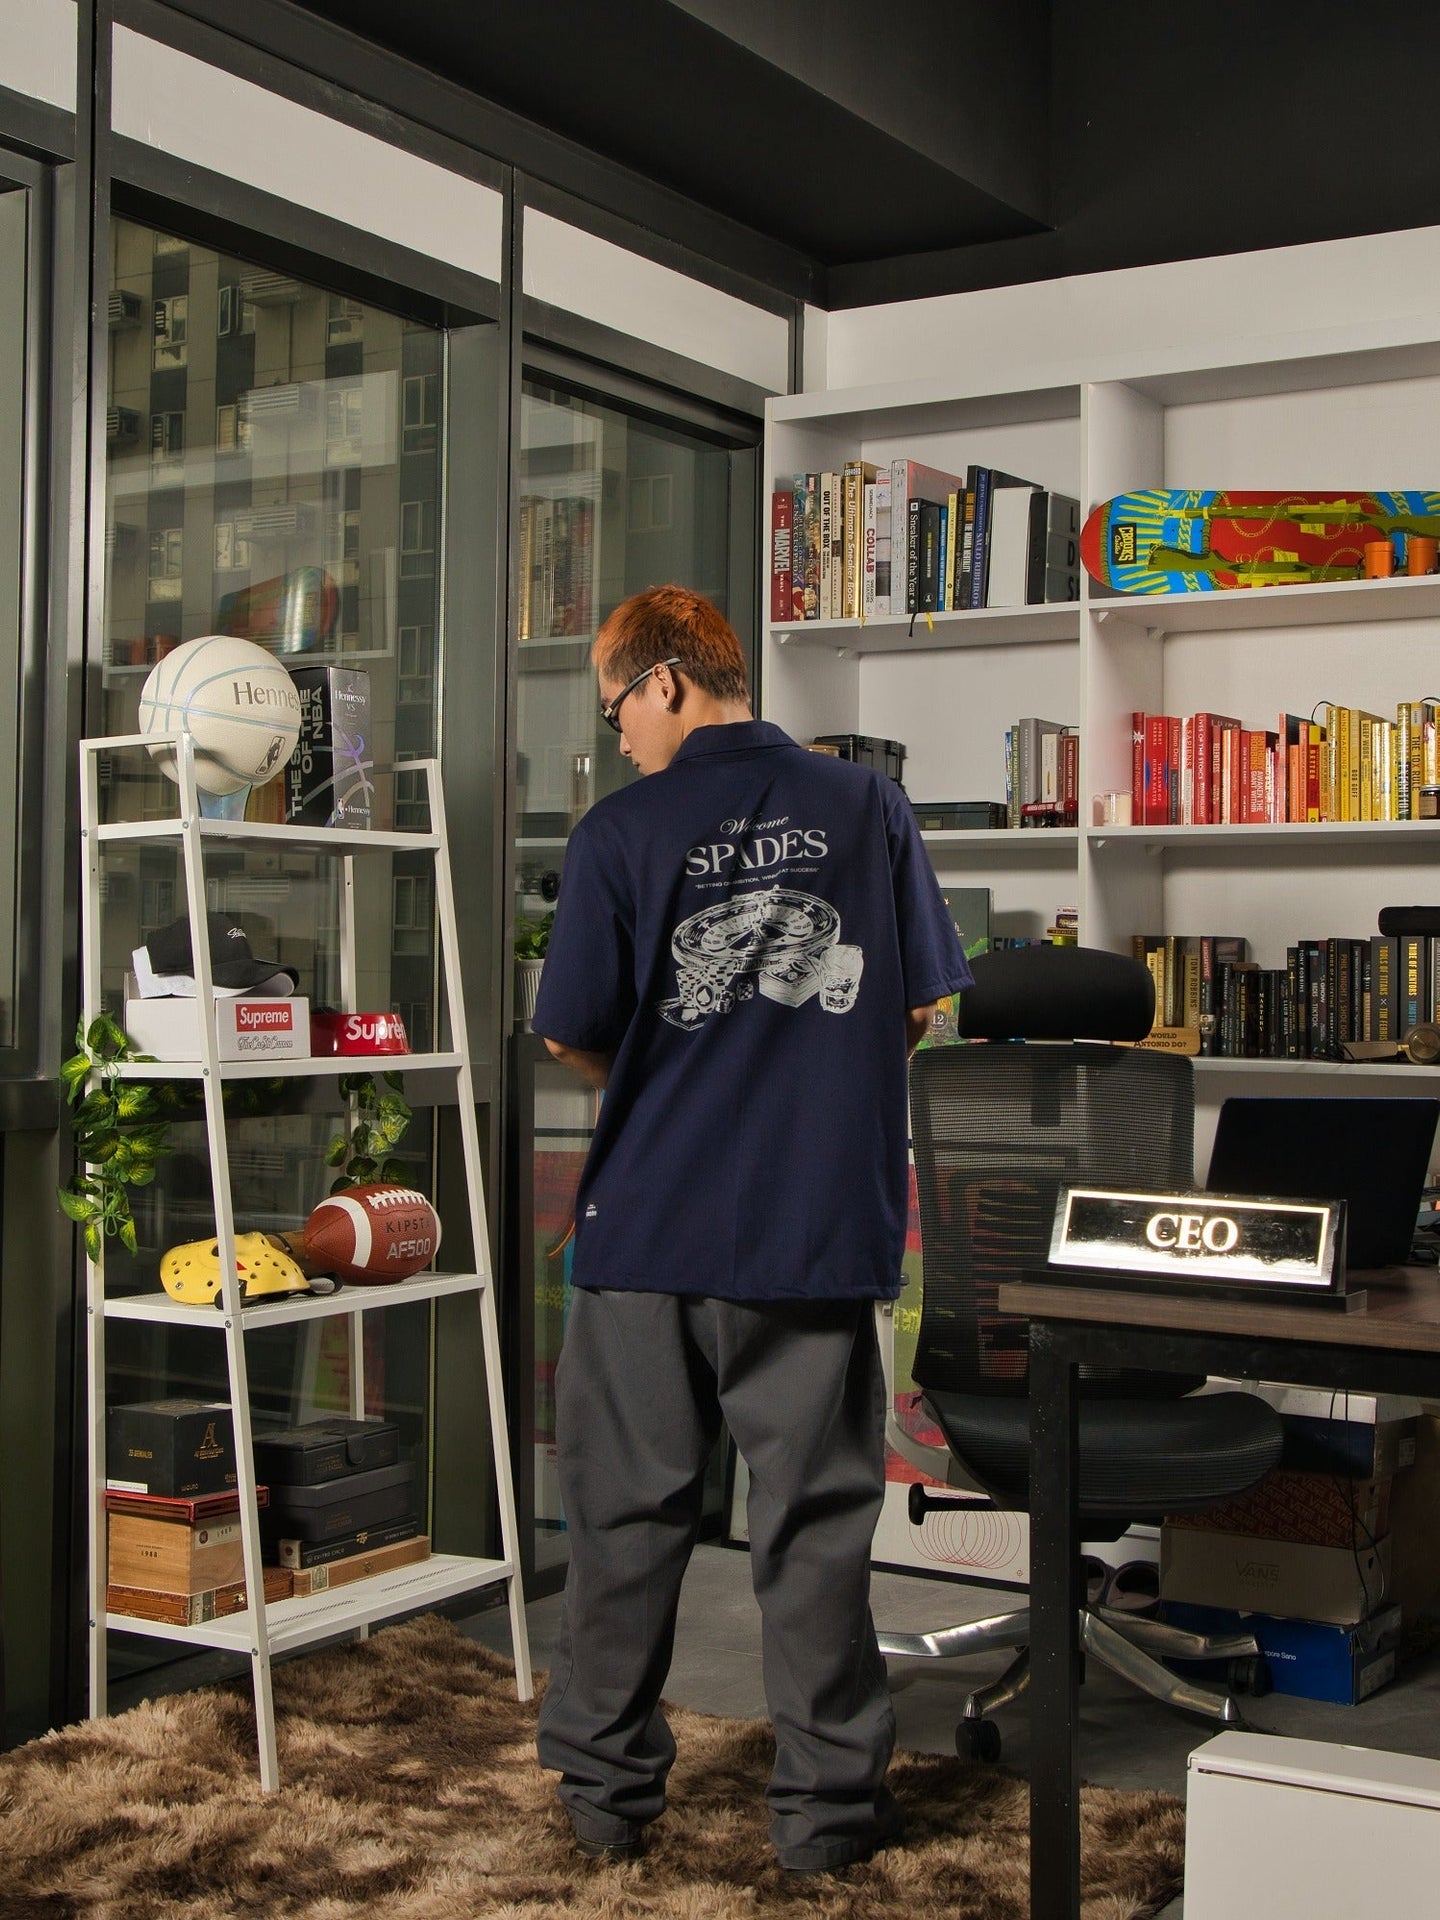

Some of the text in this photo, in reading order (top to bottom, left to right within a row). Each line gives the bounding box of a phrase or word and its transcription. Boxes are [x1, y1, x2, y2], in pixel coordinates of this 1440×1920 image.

[823, 507, 830, 516] OF
[965, 523, 973, 531] THE
[774, 528, 790, 574] MARVEL
[847, 480, 856, 605] The Ultimate Sneaker Book
[866, 528, 875, 573] COLLAB
[908, 514, 918, 597] Sneaker of the Year
[1118, 526, 1134, 561] CROOKS
[972, 532, 983, 600] SAULO RIBEIRO
[311, 686, 323, 739] NBA
[335, 690, 366, 706] Hennessy
[300, 688, 313, 774] OF THE
[1412, 735, 1420, 750] THE
[1212, 742, 1220, 774] RELENTLESS
[1250, 736, 1258, 770] ROBBINS
[1412, 754, 1420, 768] 10X
[290, 770, 302, 817] THE
[1398, 764, 1409, 814] EXECUTION
[1412, 770, 1420, 791] RULE
[348, 806, 370, 816] Hennessy
[720, 813, 790, 836] Wcome
[685, 829, 829, 876] SPADES
[1408, 942, 1418, 959] TRIBE
[1408, 960, 1417, 968] OF
[1379, 946, 1388, 1041] TOOLS OF TITANS TIM FERRIS
[1408, 969, 1417, 996] MENTORS
[240, 1006, 289, 1028] Supreme
[1146, 1213, 1239, 1251] CEO
[386, 1237, 430, 1260] AF500
[1236, 1560, 1280, 1582] VANS
